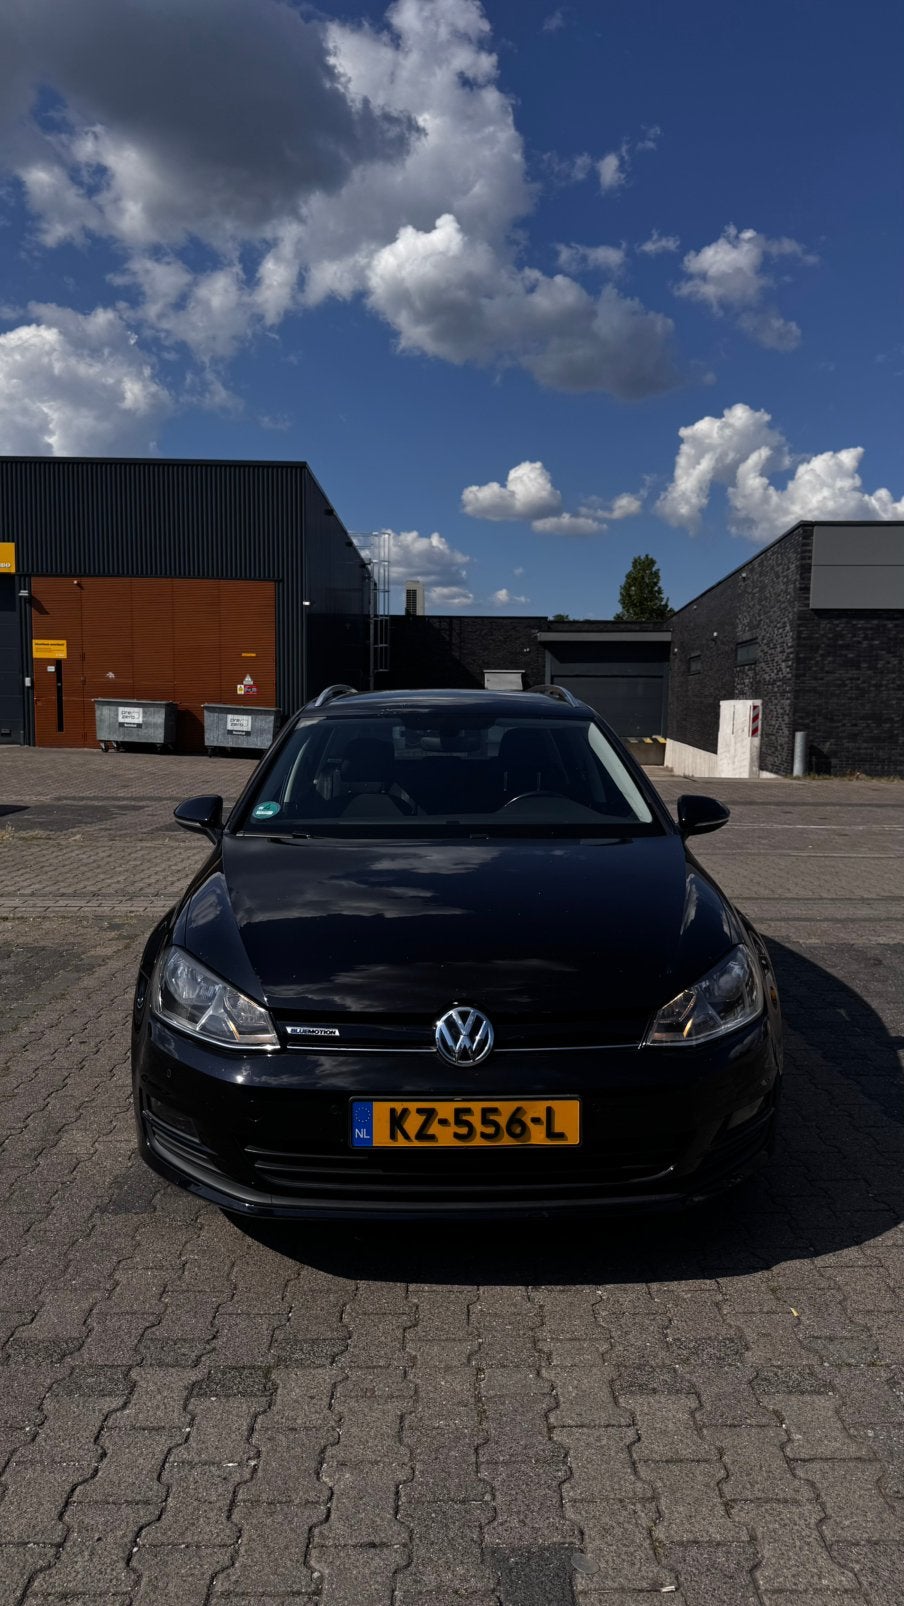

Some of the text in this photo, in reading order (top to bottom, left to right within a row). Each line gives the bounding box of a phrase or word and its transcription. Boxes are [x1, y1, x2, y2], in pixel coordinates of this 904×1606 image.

[289, 1027, 337, 1035] BLUEMOTION
[389, 1106, 569, 1141] KZ-556-L
[355, 1128, 371, 1139] NL
